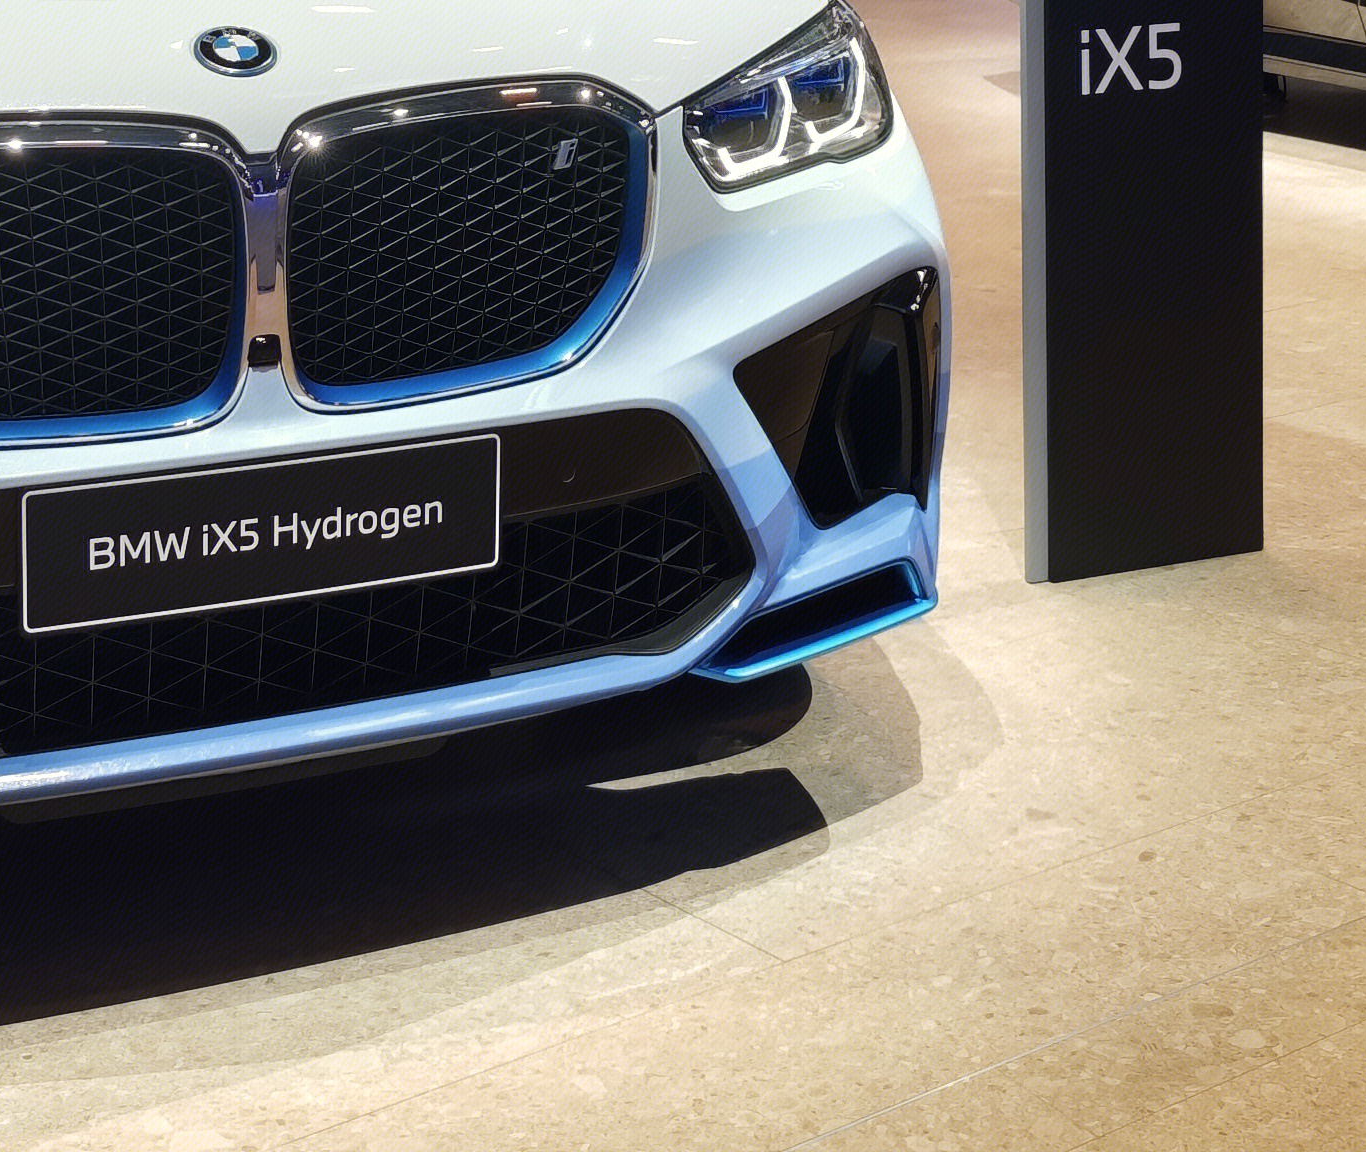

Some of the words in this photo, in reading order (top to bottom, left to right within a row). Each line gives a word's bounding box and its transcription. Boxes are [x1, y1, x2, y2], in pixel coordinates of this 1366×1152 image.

[1080, 22, 1183, 96] iX5
[88, 526, 191, 571] BMW
[201, 517, 260, 557] iX5
[272, 499, 443, 550] Hydrogen
